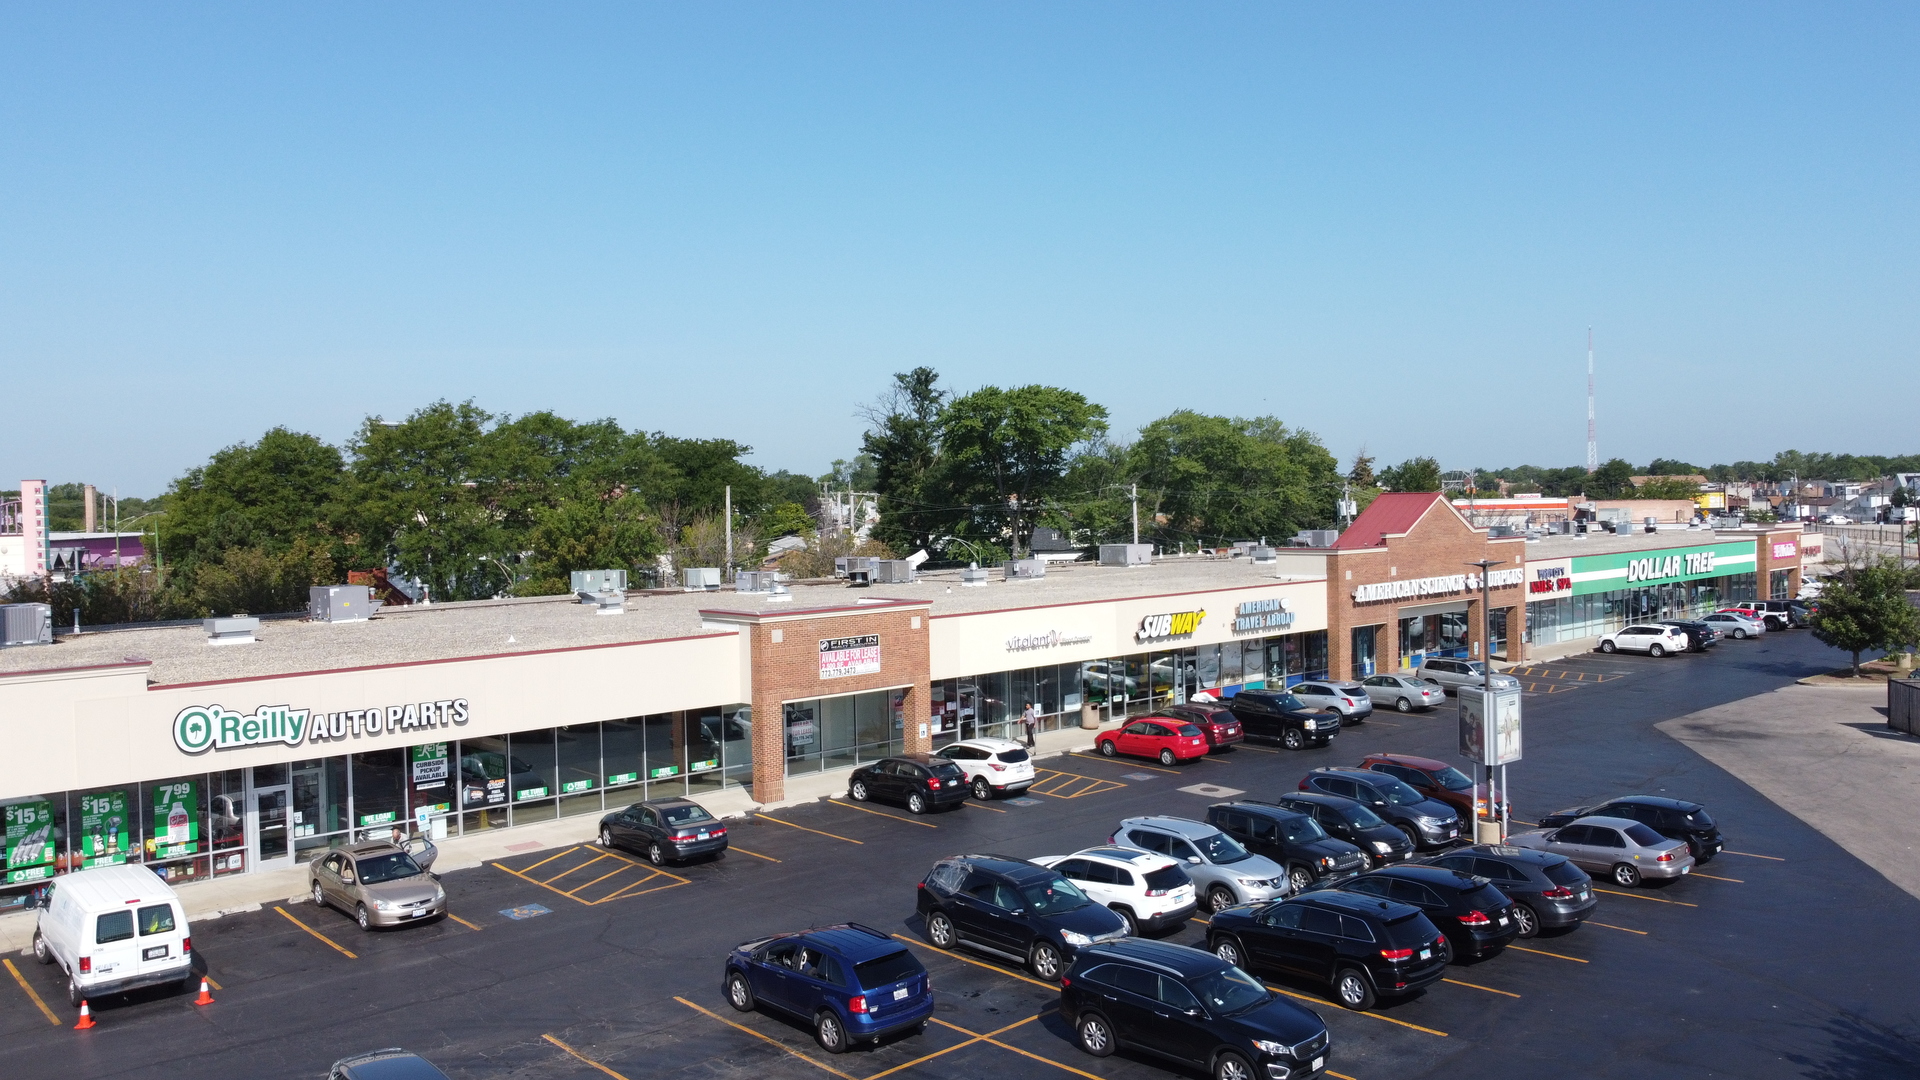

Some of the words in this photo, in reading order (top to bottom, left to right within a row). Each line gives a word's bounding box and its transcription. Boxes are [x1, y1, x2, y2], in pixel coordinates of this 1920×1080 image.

[1627, 555, 1681, 582] DOLLAR
[1685, 551, 1715, 575] TREE
[1354, 578, 1420, 602] AMERICAN
[1420, 574, 1466, 594] SCIENCE
[1466, 573, 1479, 589] &
[1529, 579, 1552, 594] NAILS
[1557, 577, 1572, 590] SPA
[1239, 599, 1280, 615] AMERICAN
[1137, 610, 1207, 640] SUBWAY
[1235, 615, 1264, 631] TRAVEL
[1266, 612, 1296, 627] ABROAD
[831, 637, 863, 647] FIRST
[1005, 634, 1050, 649] vitalant
[821, 650, 850, 663] AVAILABLE
[850, 649, 861, 660] FOR
[862, 647, 878, 659] LEASE
[180, 709, 308, 748] O'Reilly
[310, 707, 381, 740] AUTO
[387, 698, 468, 731] PARTS
[415, 760, 444, 769] CURBSIDE
[419, 766, 441, 774] PICKUP
[415, 771, 446, 781] AVAILABLE
[520, 789, 530, 797] WE
[531, 787, 544, 796] TURN
[574, 780, 588, 789] FREE
[82, 797, 110, 814] $15
[6, 807, 36, 825] $15
[364, 815, 374, 823] WE
[375, 812, 392, 820] LOAN
[168, 844, 186, 853] FREE
[94, 856, 114, 866] FREE
[25, 867, 46, 877] FREE
